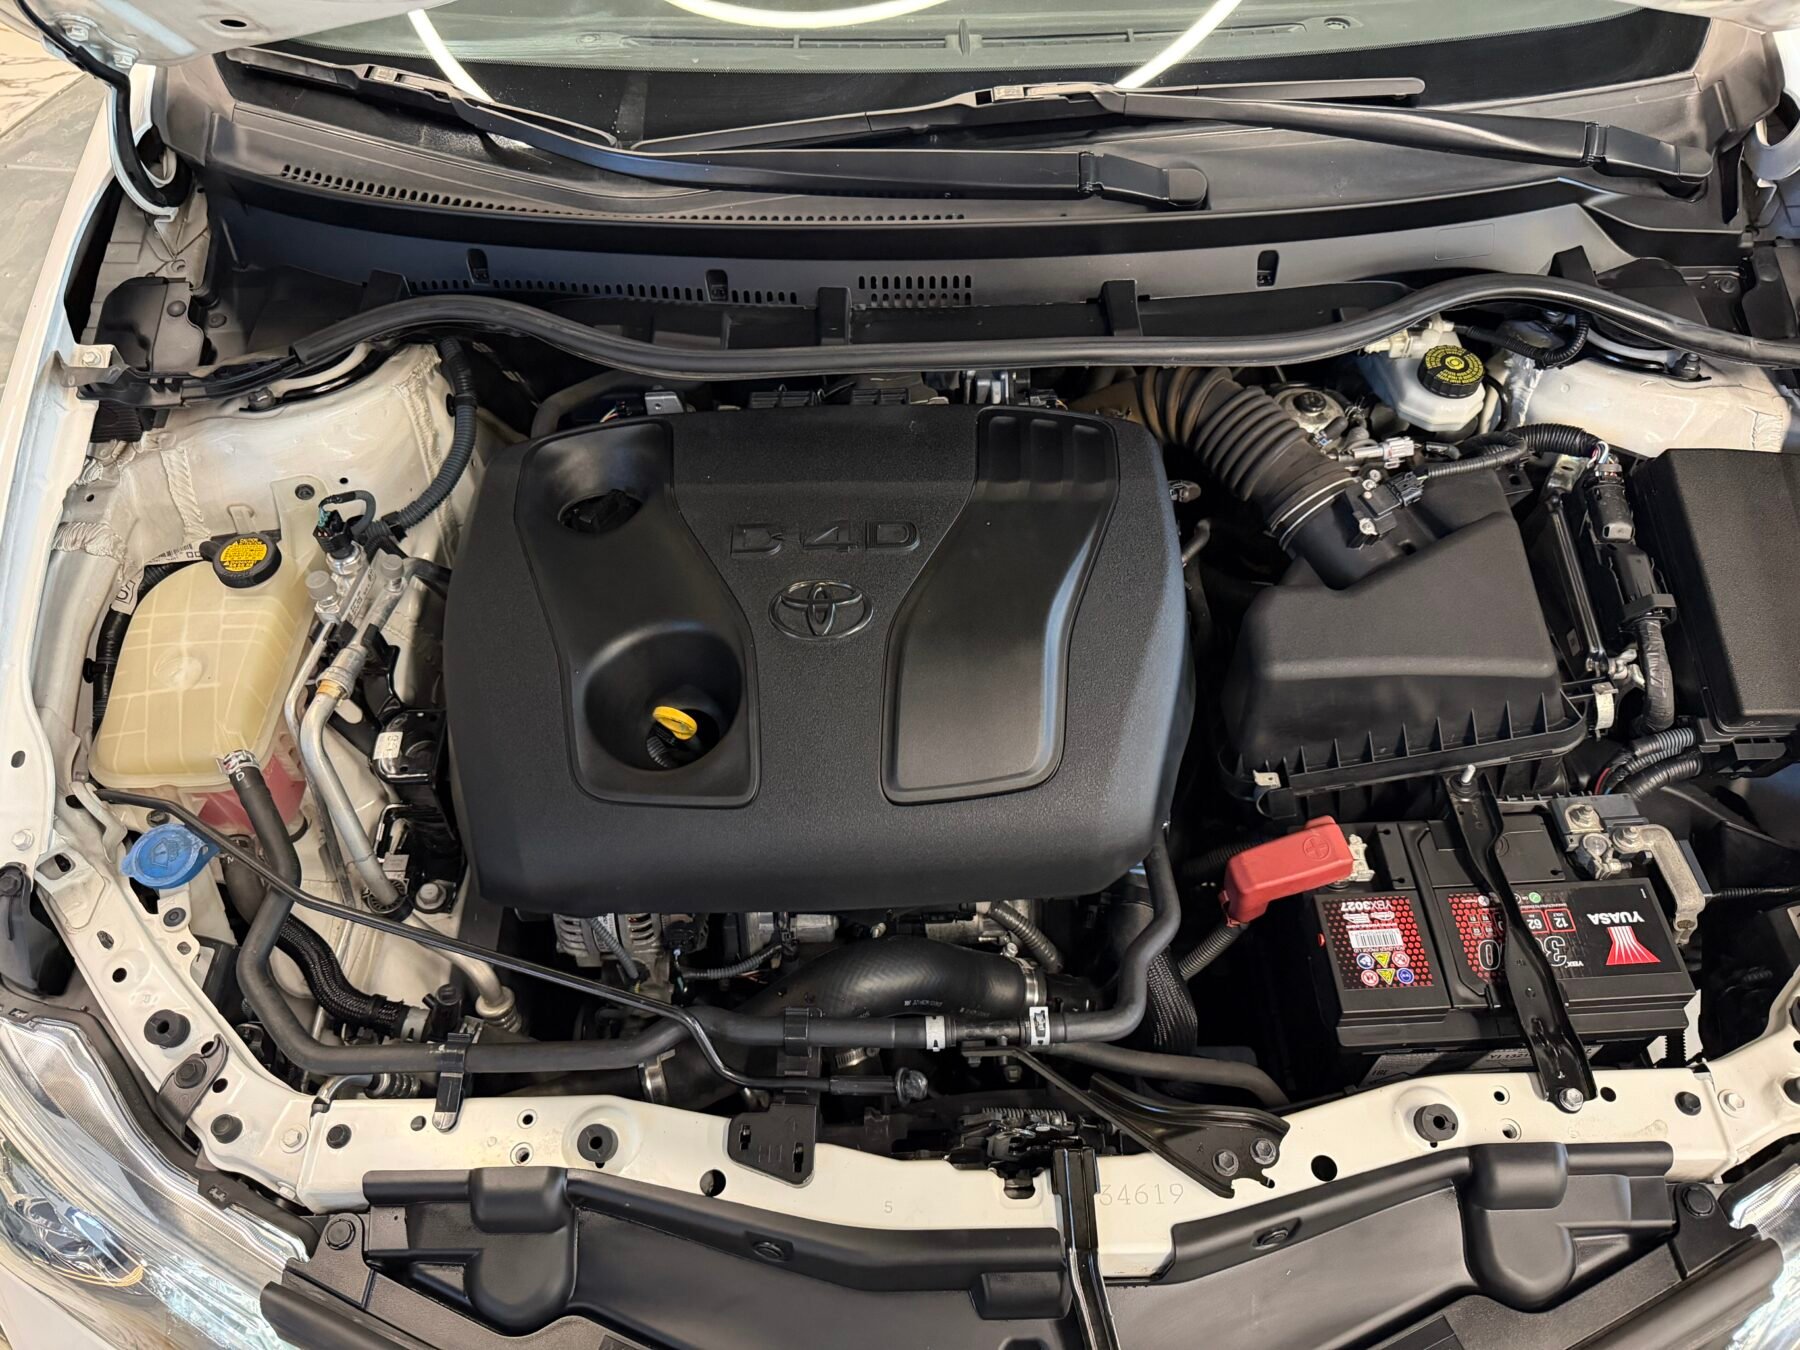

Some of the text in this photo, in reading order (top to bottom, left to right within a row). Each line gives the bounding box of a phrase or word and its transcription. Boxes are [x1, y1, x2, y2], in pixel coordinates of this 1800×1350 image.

[1340, 900, 1393, 912] YBX3027
[1526, 918, 1543, 930] 62
[1553, 917, 1569, 928] 12
[1586, 911, 1645, 925] YUASA
[1100, 1183, 1184, 1206] 34619
[884, 1200, 893, 1214] 5
